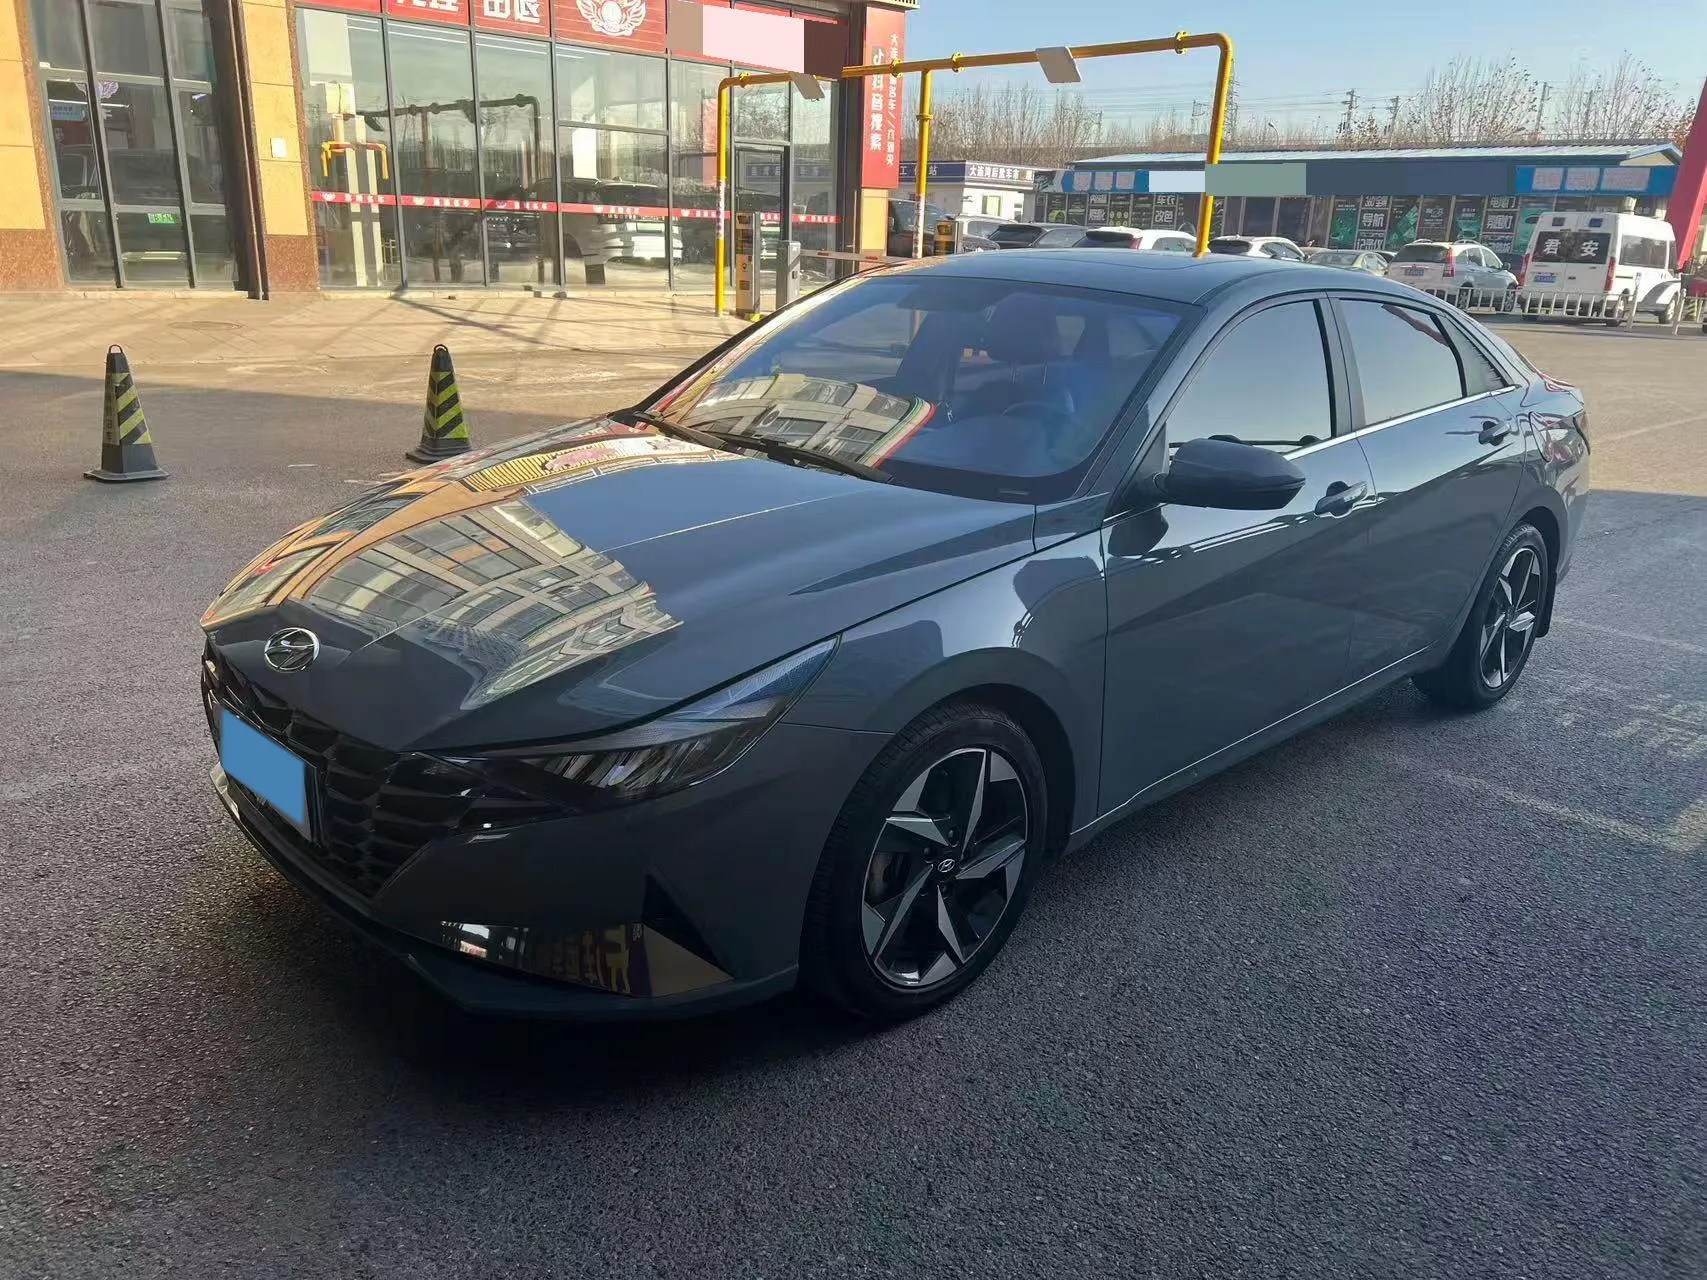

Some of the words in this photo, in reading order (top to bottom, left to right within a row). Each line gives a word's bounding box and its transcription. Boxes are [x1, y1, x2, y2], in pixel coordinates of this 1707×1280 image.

[1155, 210, 1174, 223] 改色
[1362, 213, 1385, 227] 导航
[1544, 238, 1561, 255] 君
[1580, 240, 1599, 257] 安
